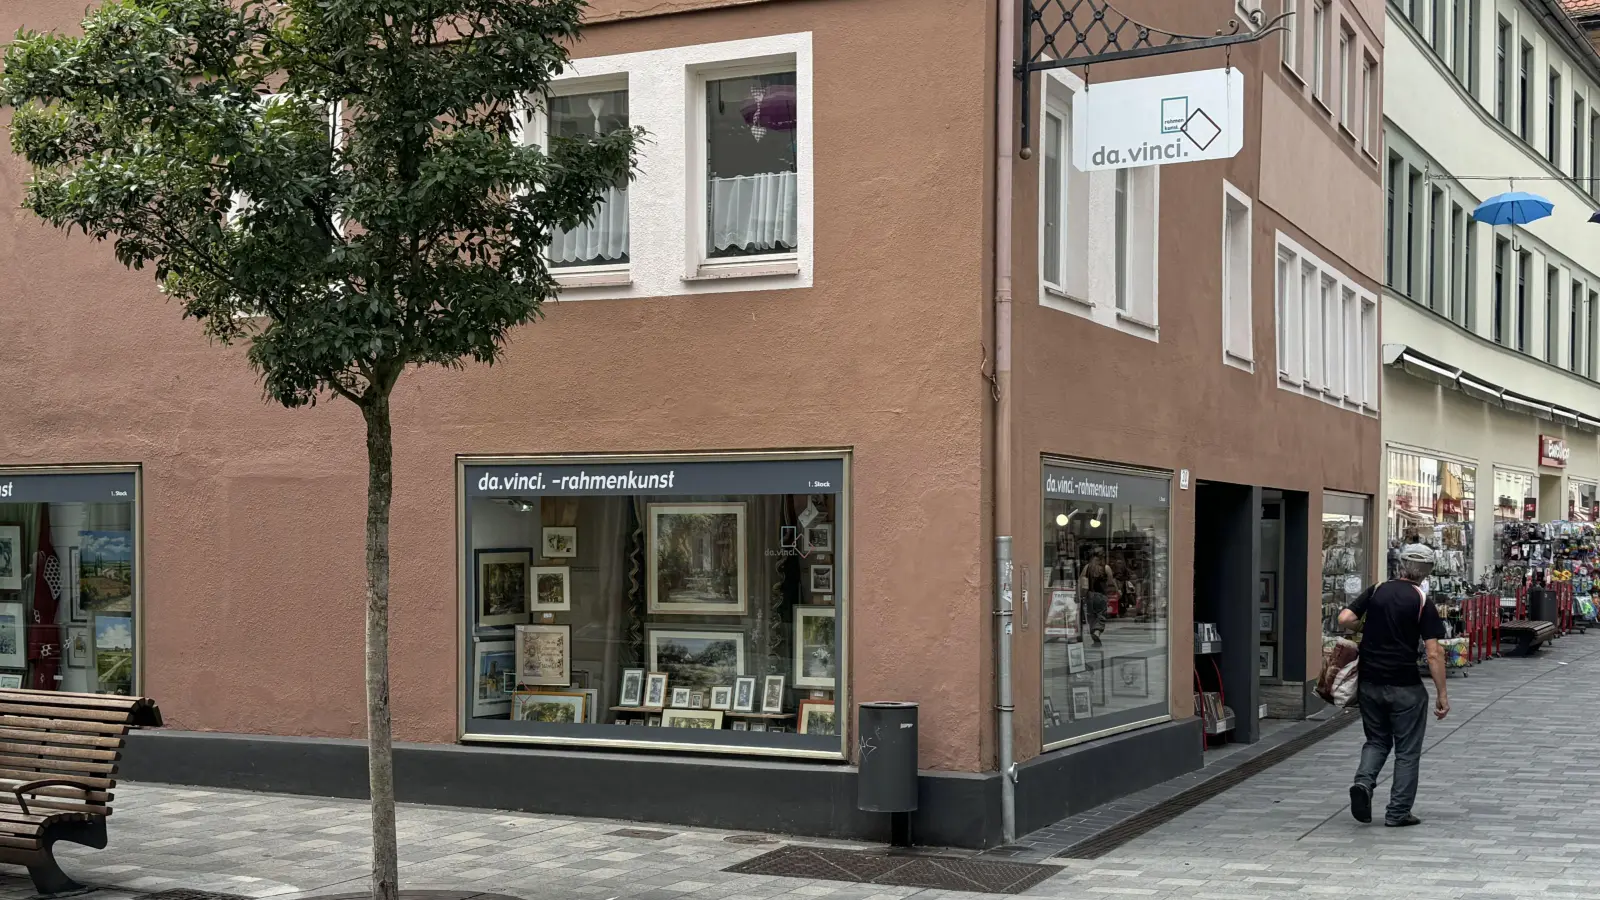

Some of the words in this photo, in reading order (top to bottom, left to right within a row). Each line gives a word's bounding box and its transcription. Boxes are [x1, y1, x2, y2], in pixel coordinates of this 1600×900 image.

[1092, 138, 1188, 165] da.vinci.
[0, 481, 13, 497] st
[478, 472, 546, 491] da.vinci.
